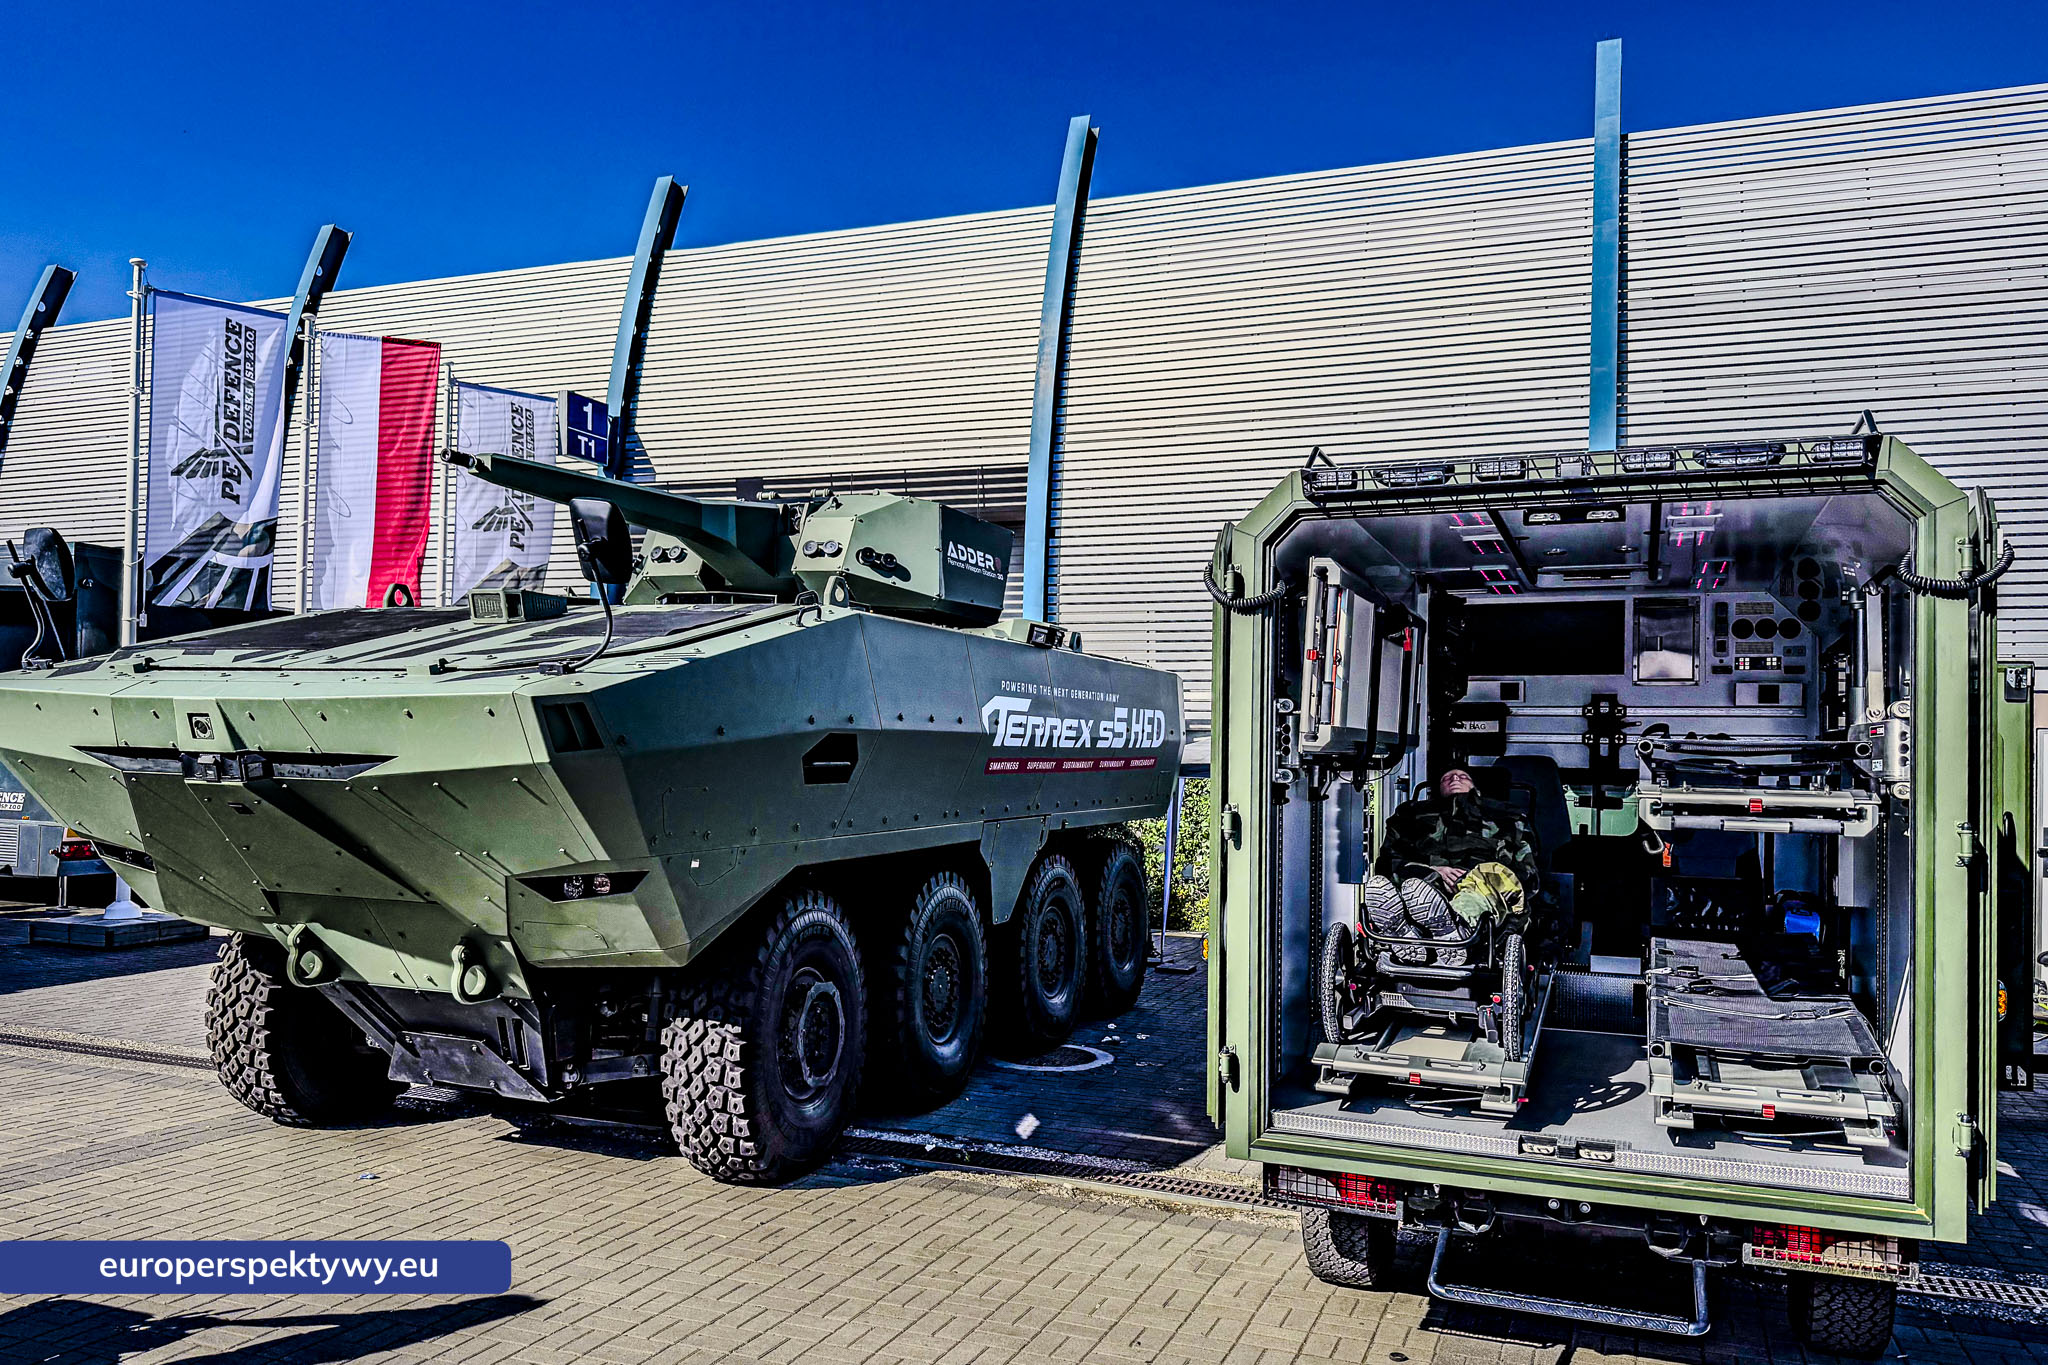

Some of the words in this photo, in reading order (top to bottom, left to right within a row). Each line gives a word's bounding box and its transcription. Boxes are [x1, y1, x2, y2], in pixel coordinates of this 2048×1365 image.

[222, 316, 243, 445] DEFENCE
[244, 383, 255, 440] POLSKA
[582, 402, 594, 432] 1
[577, 434, 596, 459] T1
[221, 460, 242, 506] PE
[510, 516, 526, 552] PE
[947, 540, 995, 571] ADDER
[1001, 680, 1037, 694] POWERING
[1040, 685, 1051, 696] THE
[1053, 687, 1069, 698] NEXT
[1070, 689, 1104, 702] GENERATION
[1106, 693, 1120, 703] ARMY
[1128, 708, 1166, 749] HED
[989, 761, 1020, 771] SMARTNESS
[1026, 761, 1057, 770] SUPERIORITY
[1062, 761, 1094, 769] SUSTAINABILITY
